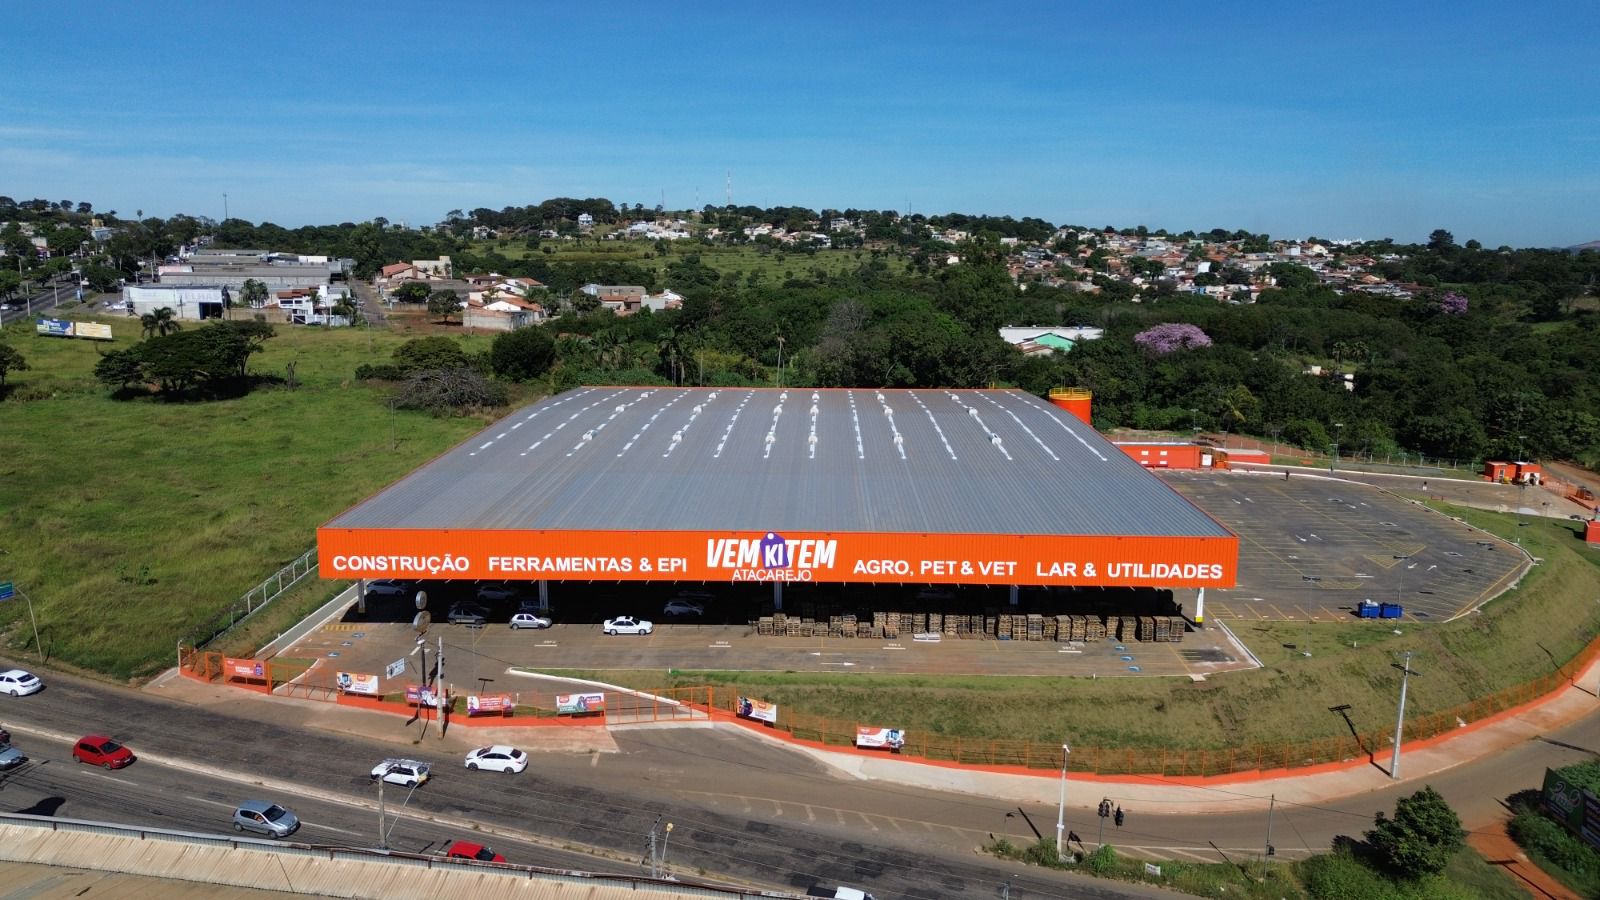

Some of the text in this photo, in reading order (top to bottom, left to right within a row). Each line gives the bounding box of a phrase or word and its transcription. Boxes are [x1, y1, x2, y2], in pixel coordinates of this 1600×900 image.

[706, 538, 761, 568] VEM
[785, 539, 838, 569] TEM
[332, 553, 470, 575] CONSTRUÇÃO
[488, 556, 687, 573] FERRAMENTAS & EPI
[853, 560, 1018, 577] AGRO, PET & VET
[1036, 562, 1223, 580] LAR & UTILIDADES
[732, 569, 812, 581] ATACAREJO
